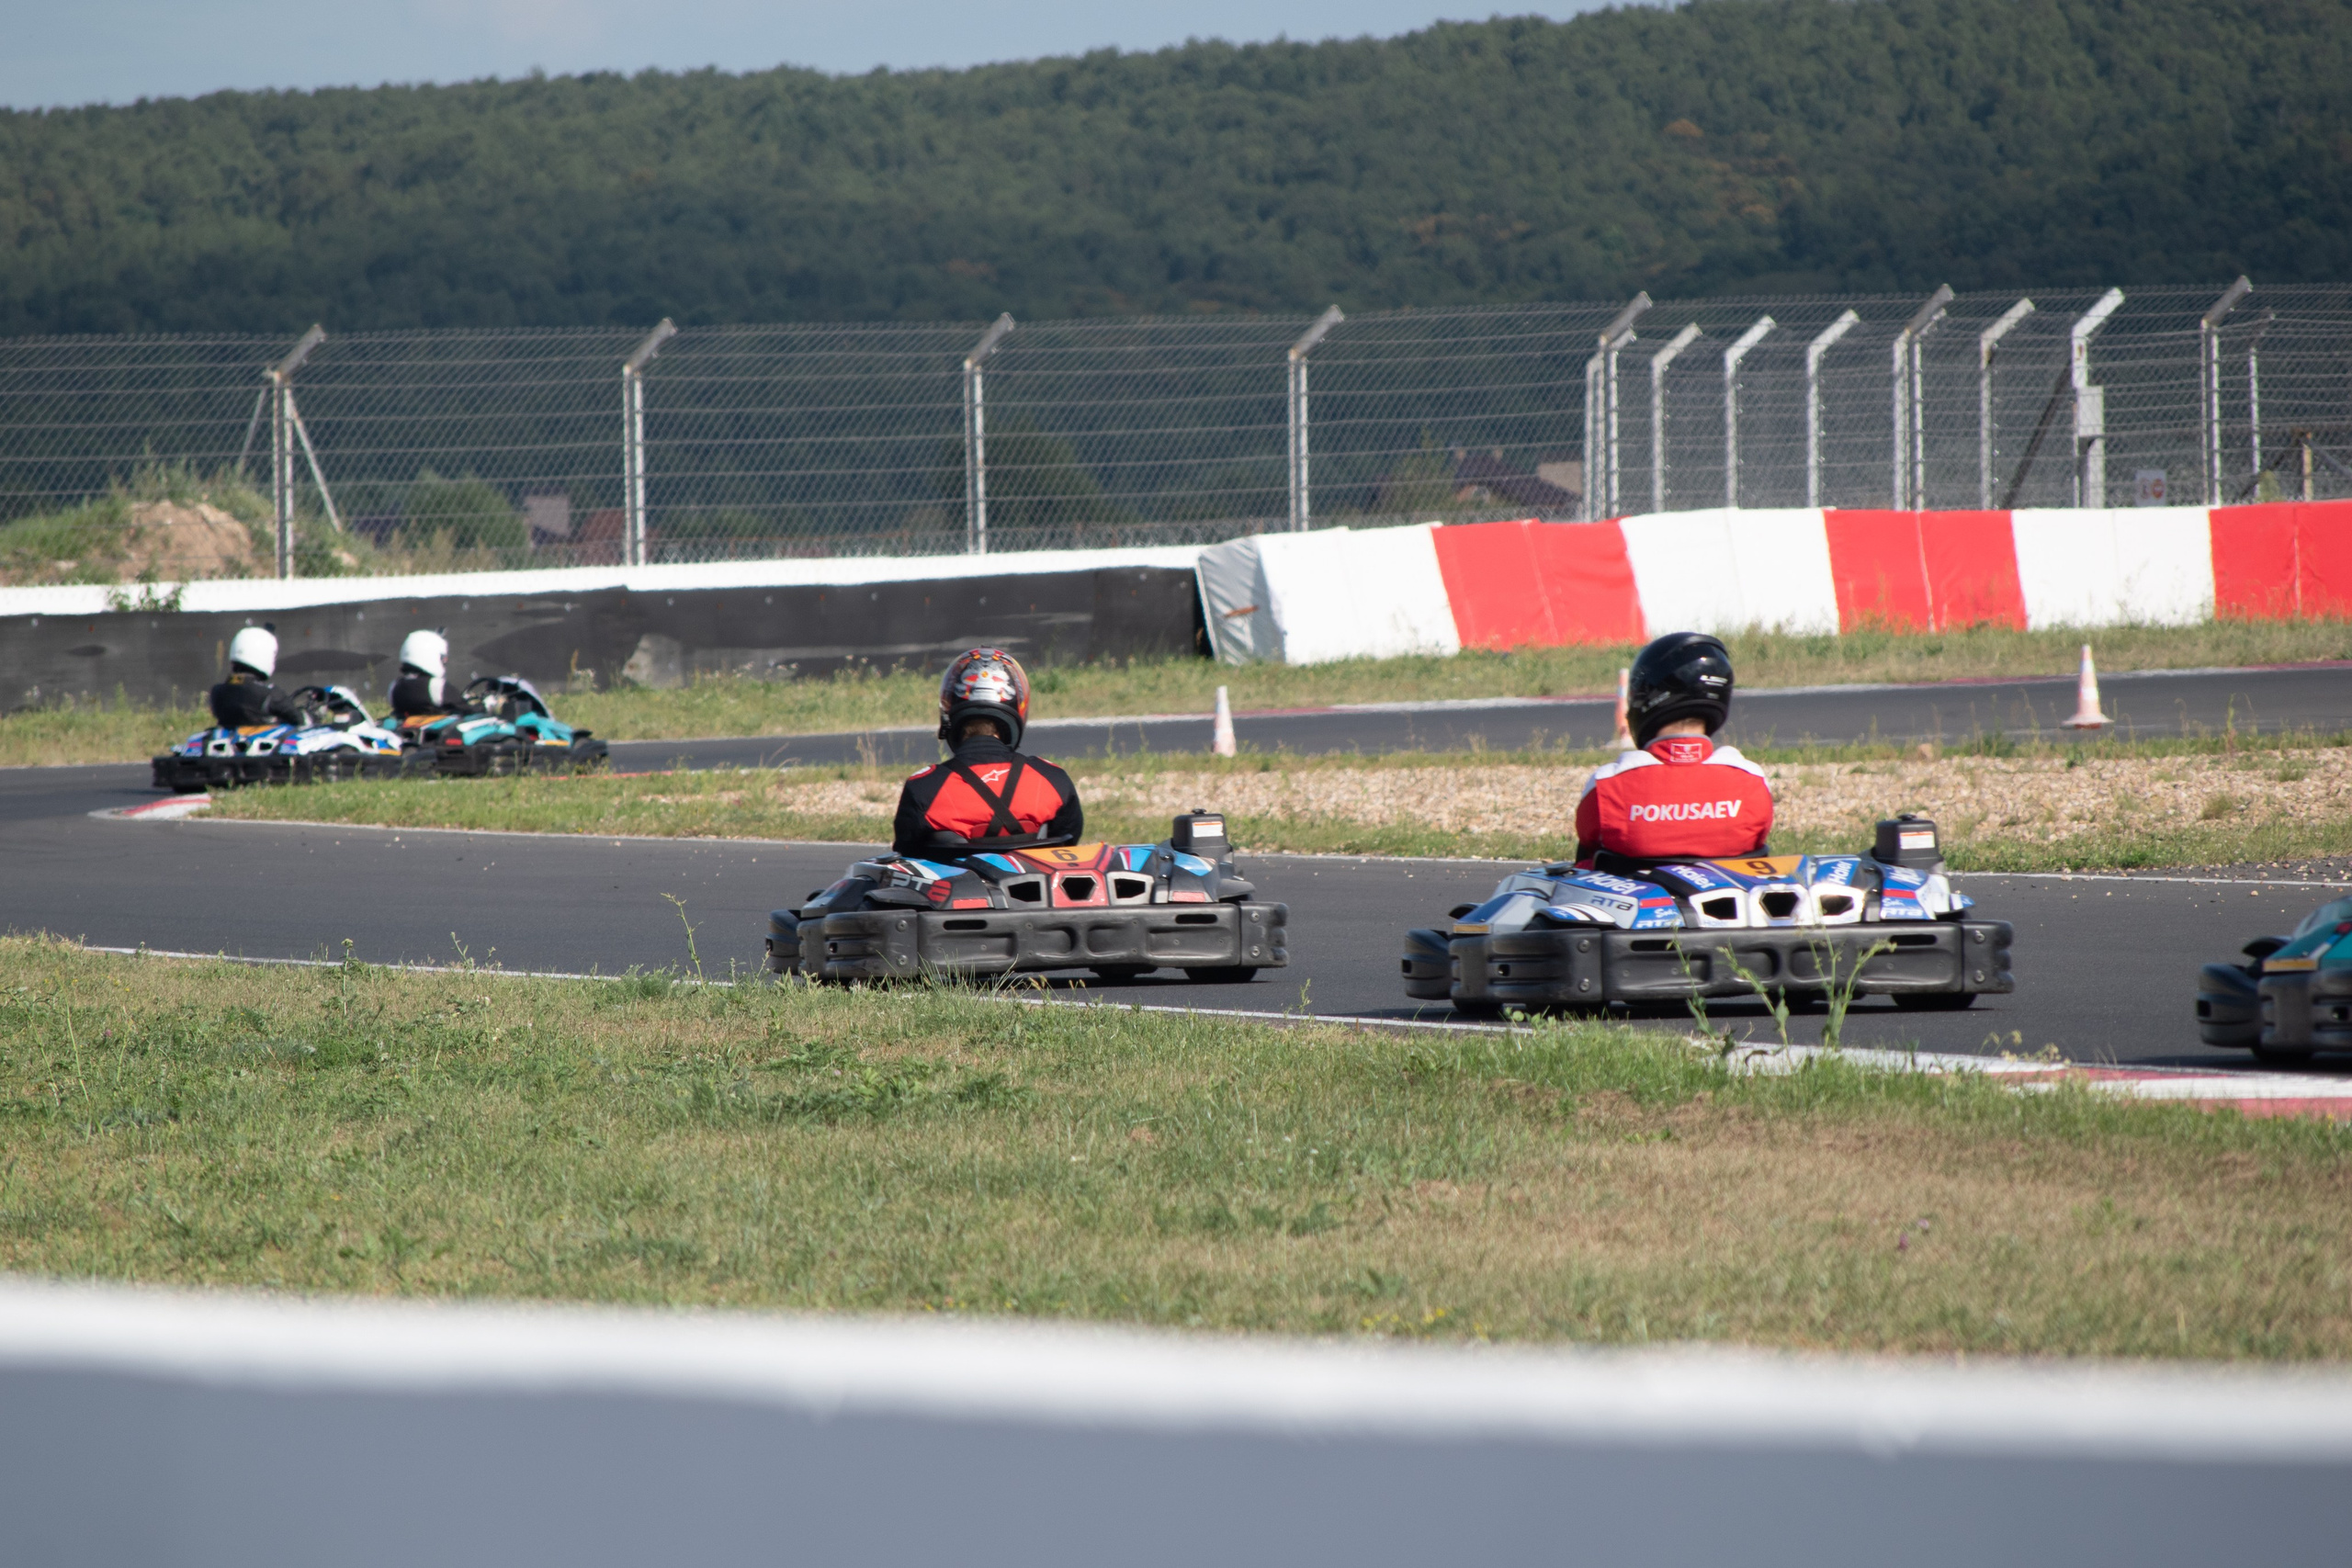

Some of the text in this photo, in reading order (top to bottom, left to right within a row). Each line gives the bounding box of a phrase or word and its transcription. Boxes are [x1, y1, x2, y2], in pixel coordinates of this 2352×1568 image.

[1630, 799, 1742, 822] POKUSAEV
[1051, 849, 1079, 862] 6
[1671, 865, 1716, 888] Haier
[1747, 860, 1777, 874] 9
[1577, 873, 1647, 895] Haier
